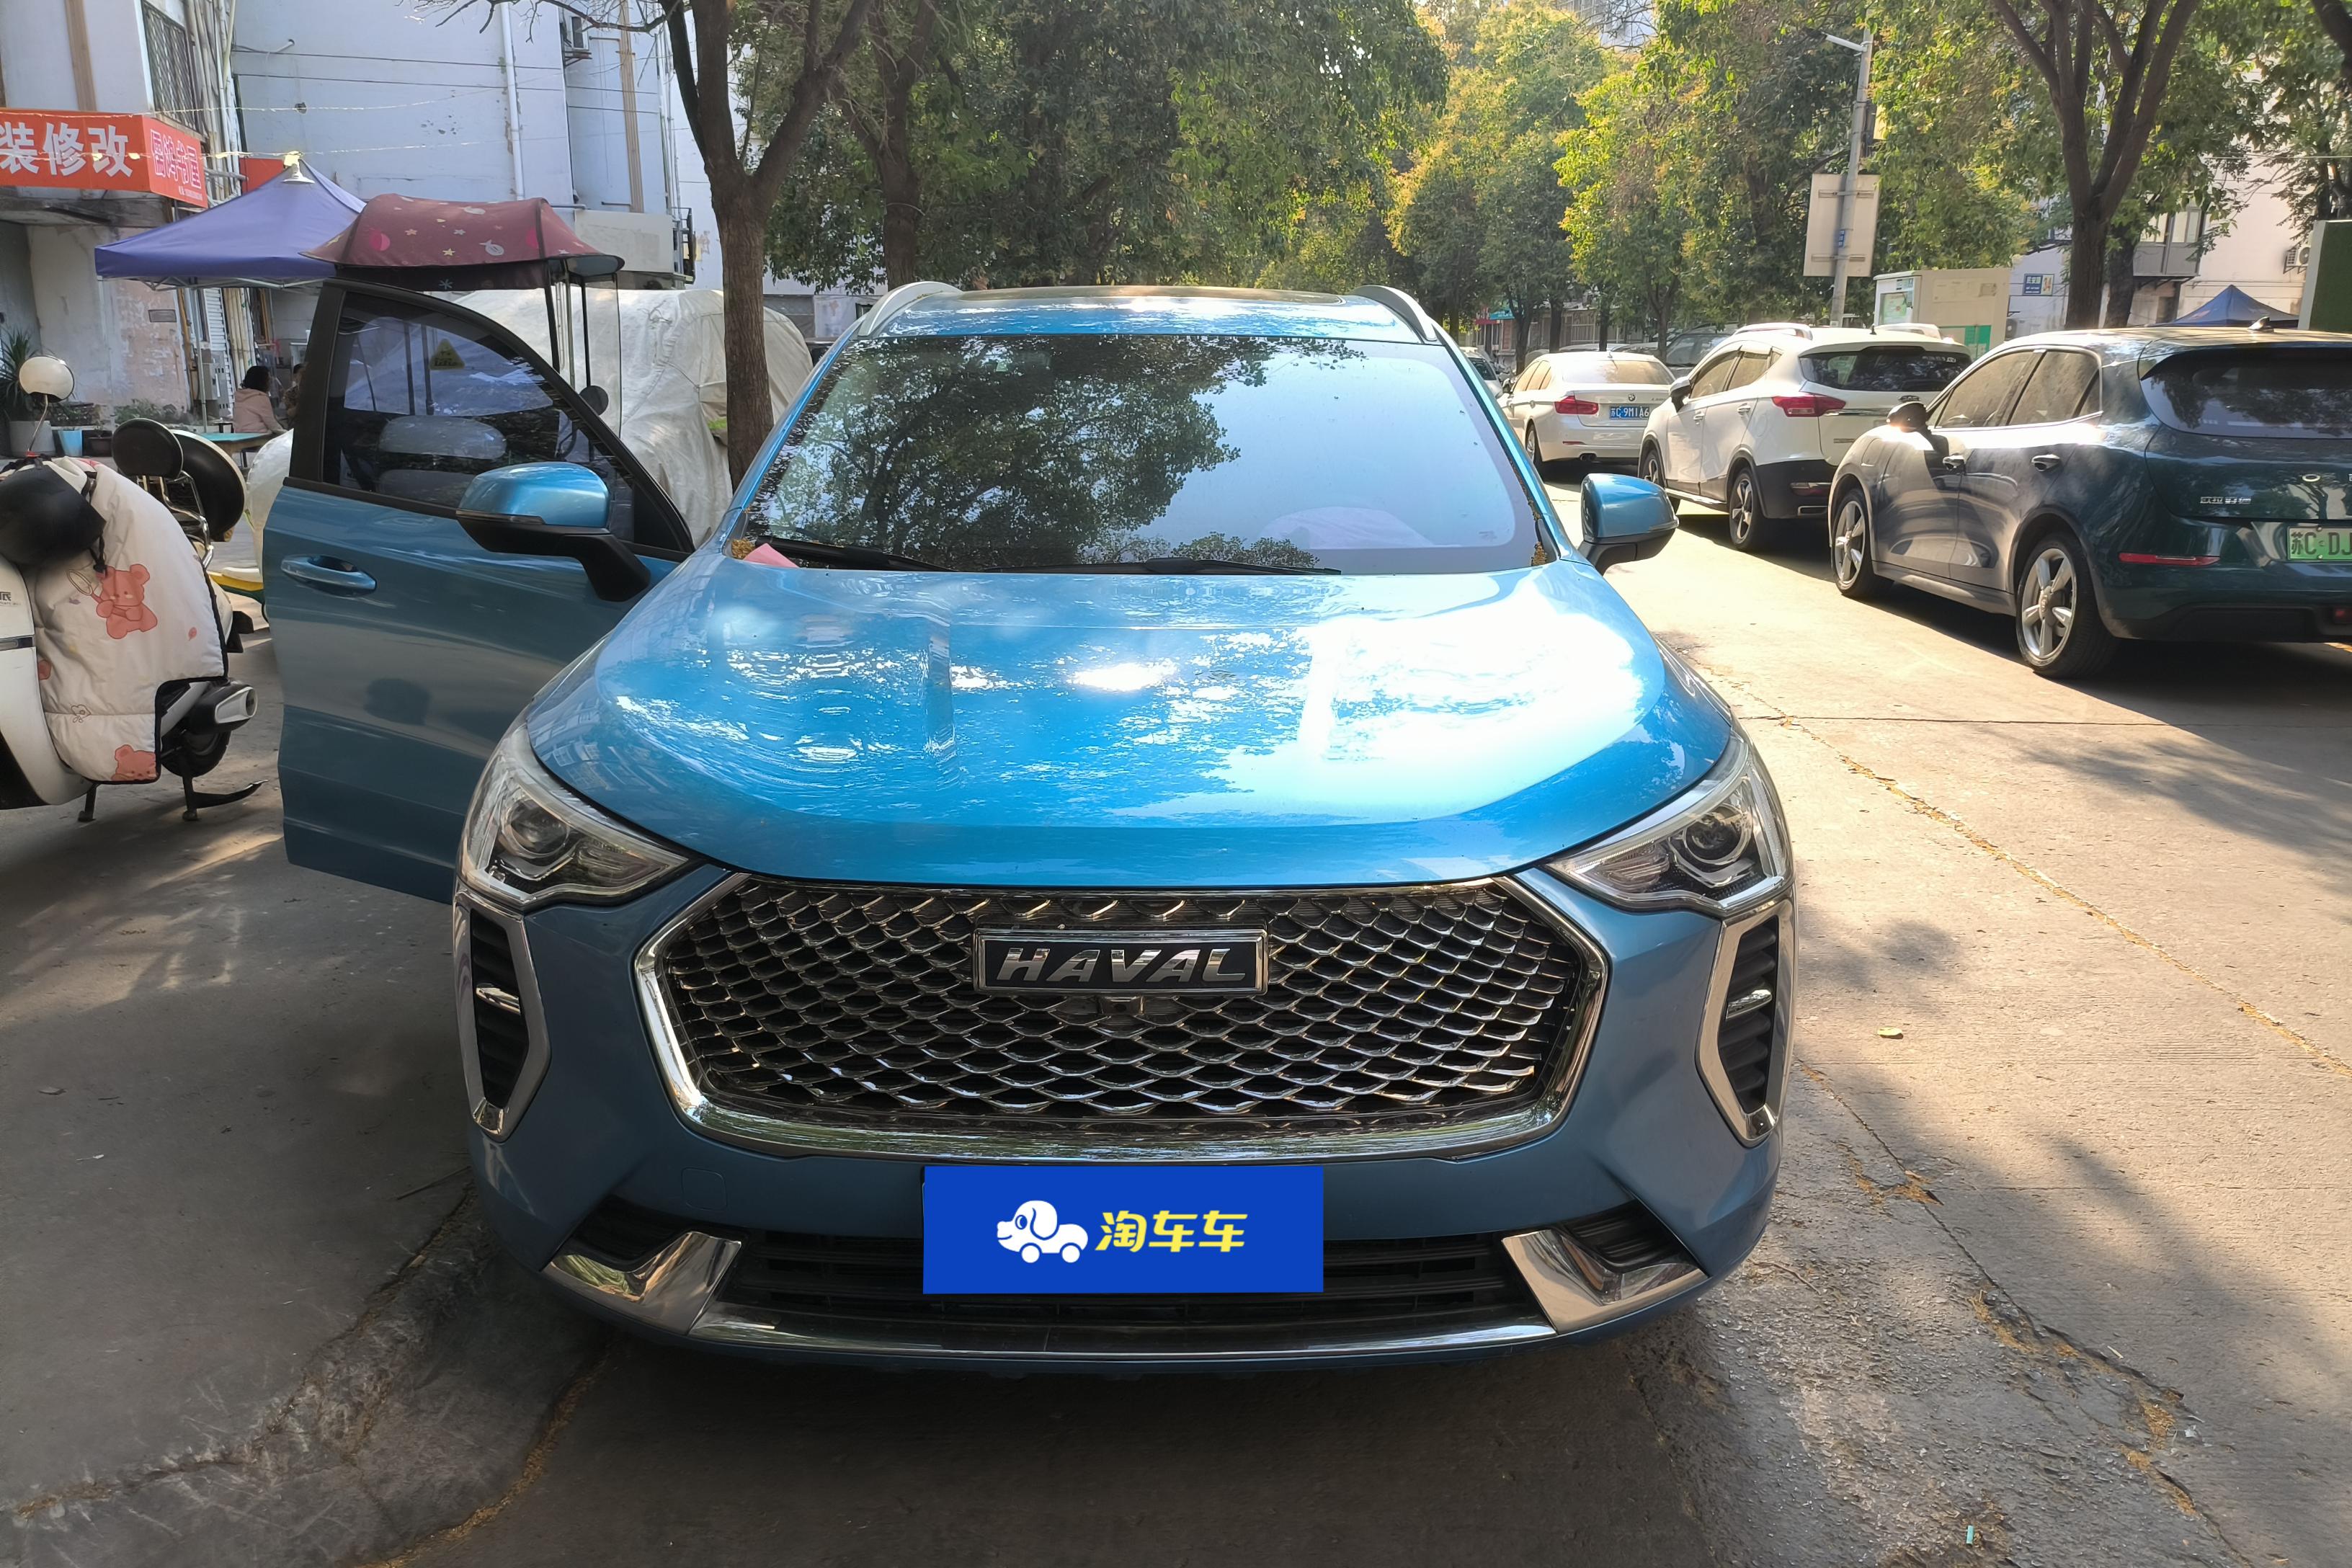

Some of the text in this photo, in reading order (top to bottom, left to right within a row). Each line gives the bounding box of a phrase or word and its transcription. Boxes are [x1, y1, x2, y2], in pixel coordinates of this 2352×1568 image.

[0, 122, 133, 177] 装修改
[997, 948, 1246, 982] HAVAL
